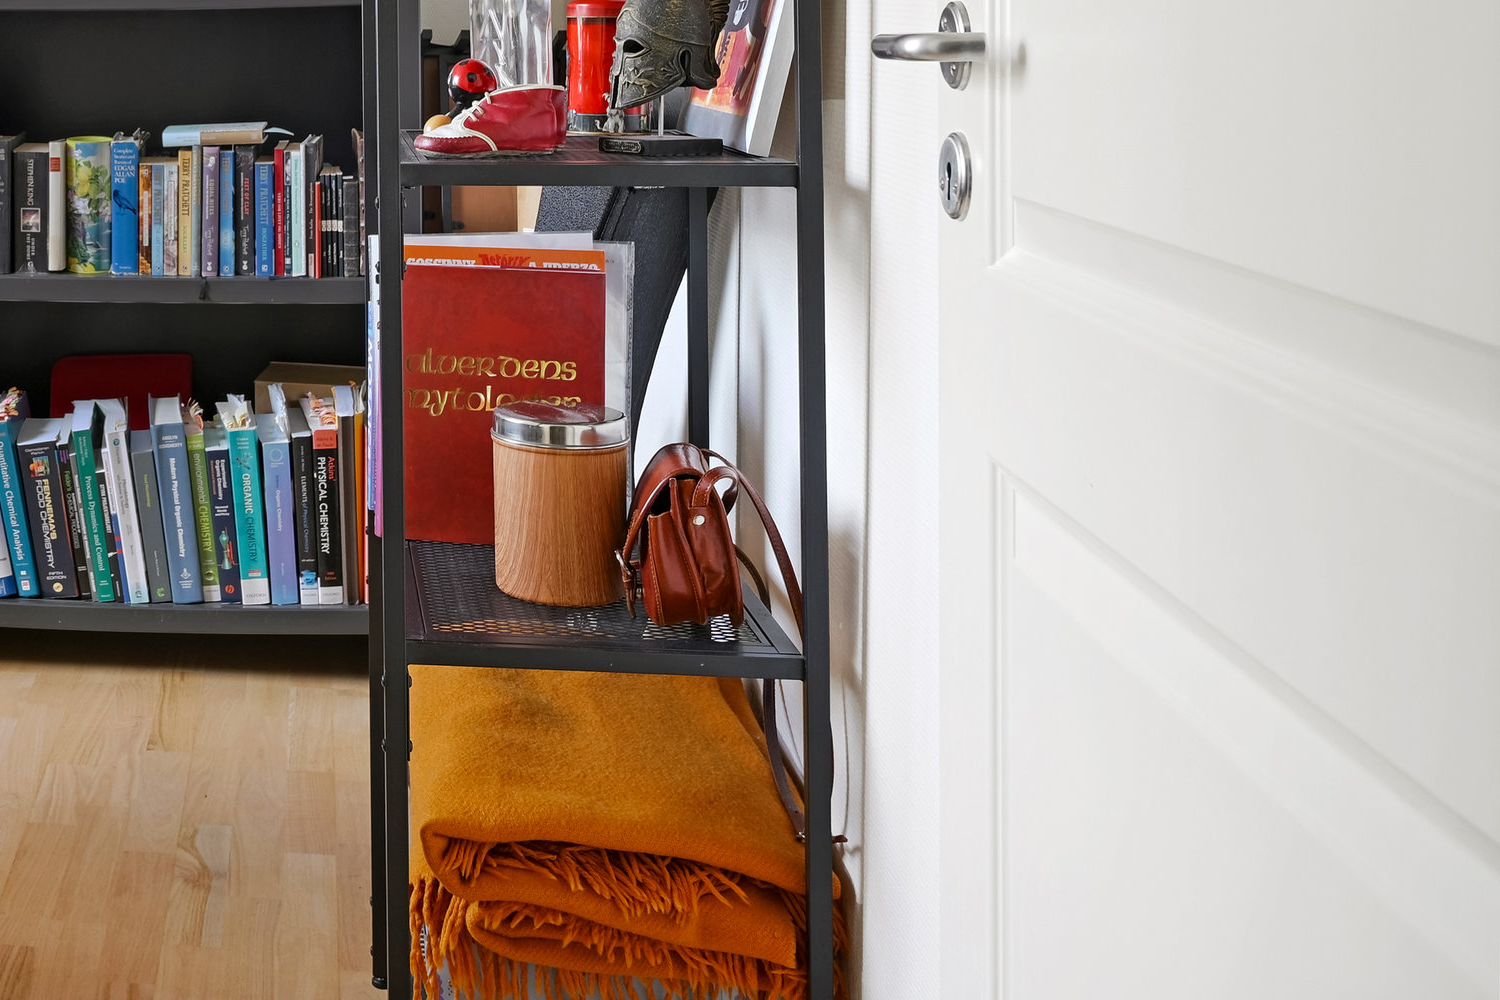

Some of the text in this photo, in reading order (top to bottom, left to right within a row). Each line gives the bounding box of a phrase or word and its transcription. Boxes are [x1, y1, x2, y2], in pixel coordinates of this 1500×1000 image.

[182, 157, 190, 216] TERRY PRATCHETT
[260, 166, 268, 185] TERRY
[244, 192, 249, 200] OF
[260, 188, 268, 225] PRATCHETT
[64, 470, 72, 491] Felder's
[84, 476, 92, 500] Process
[214, 460, 224, 500] Organic Chemistry
[328, 456, 336, 481] Atkins'
[42, 479, 57, 540] FENNEMA'S
[87, 501, 98, 533] Dynamics
[169, 458, 186, 557] Modern Physical Organic Chemistry
[193, 453, 212, 552] environmental CHEMISTRY
[242, 473, 258, 562] ORGANIC CHEMISTRY
[317, 457, 330, 554] PHYSICAL CHEMISTRY
[5, 490, 19, 527] Chemical
[12, 529, 25, 561] Analysis
[35, 479, 55, 569] FOOD CHEMISTRY
[95, 547, 105, 571] Control
